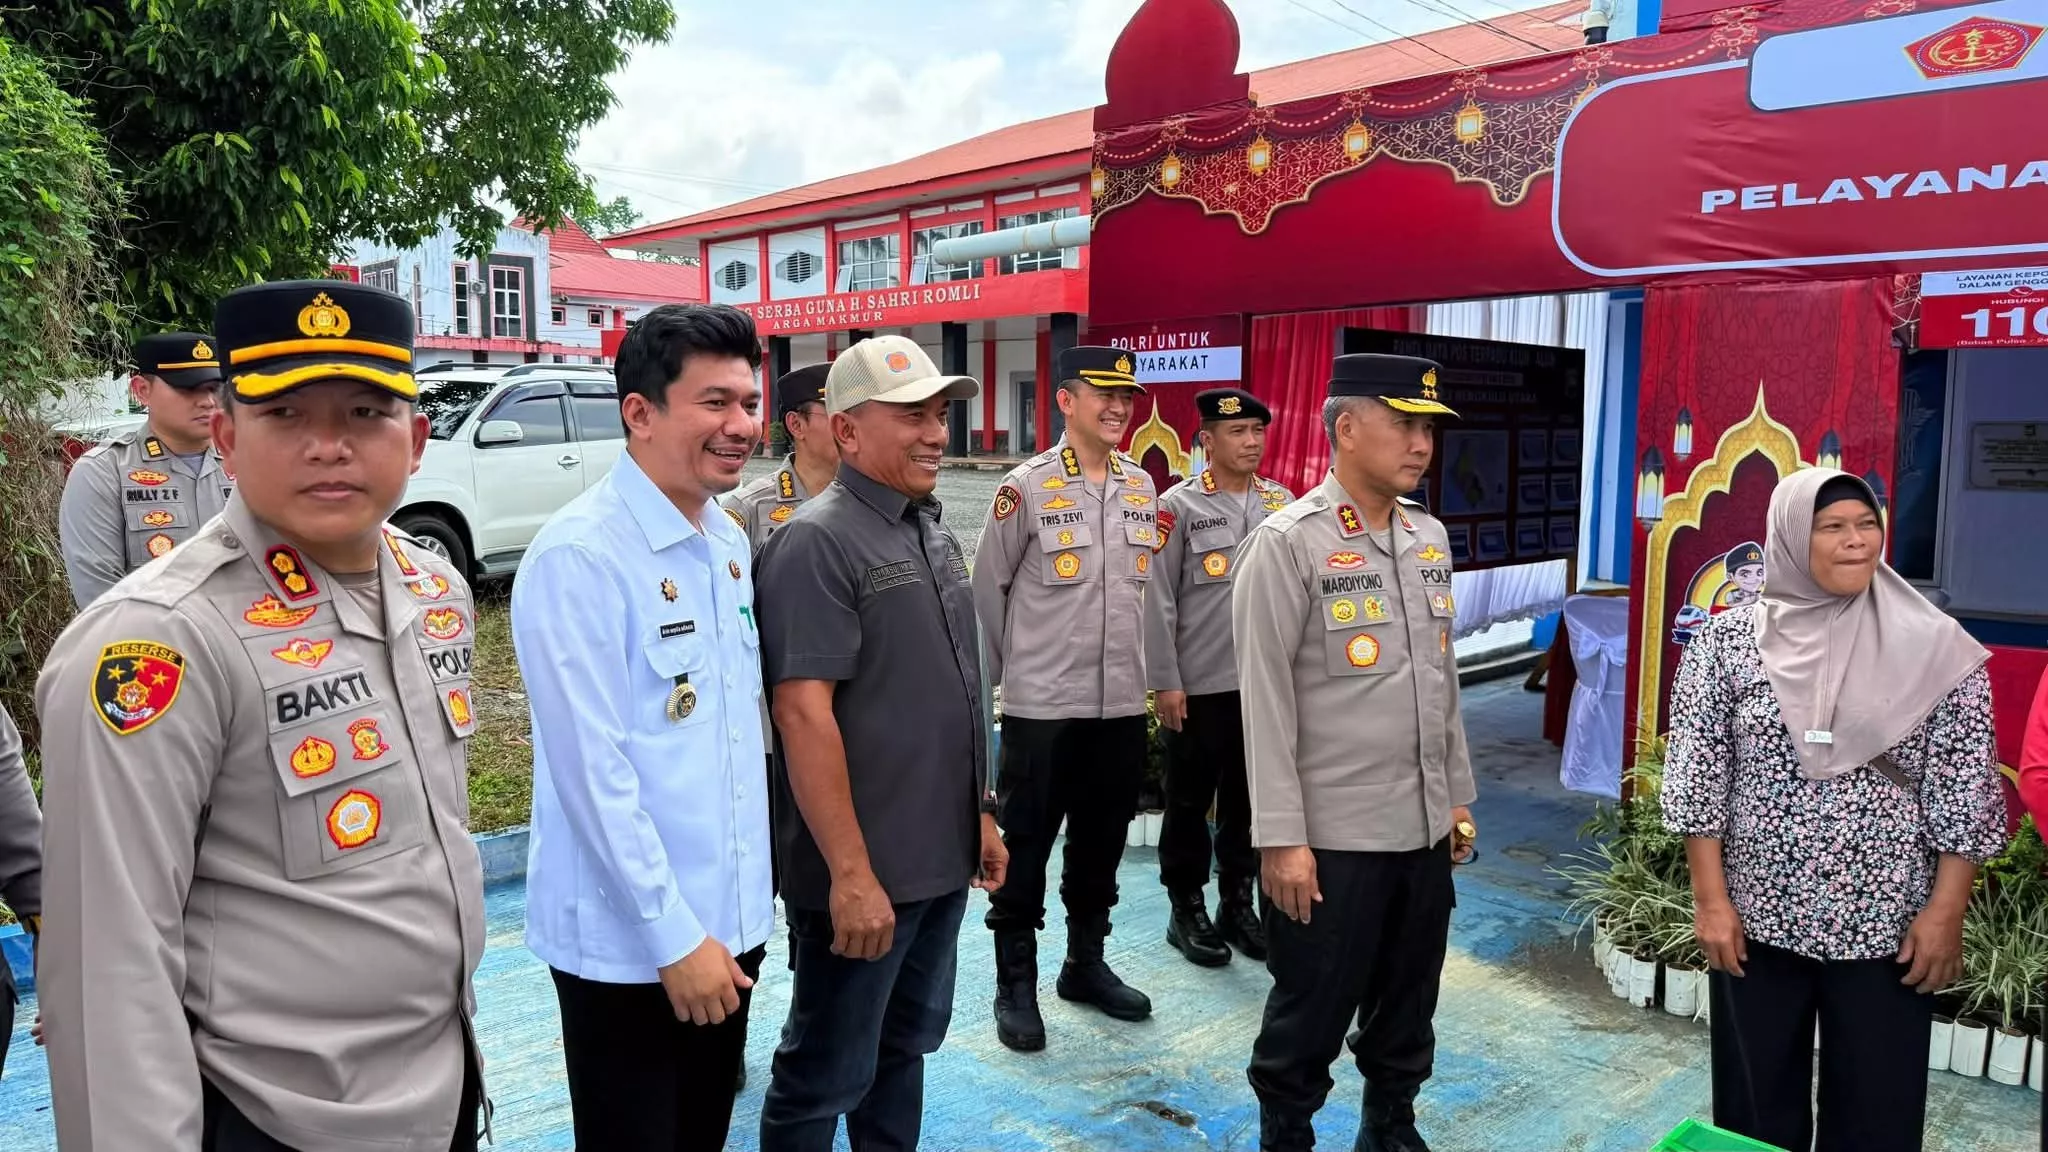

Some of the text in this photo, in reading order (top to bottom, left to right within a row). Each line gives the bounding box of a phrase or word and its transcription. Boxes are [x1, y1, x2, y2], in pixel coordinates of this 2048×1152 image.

[1701, 160, 2048, 214] PELAYANA
[1956, 273, 2012, 282] LAYANAN
[1958, 281, 2001, 289] DALAM
[757, 303, 801, 319] SERBA
[806, 299, 845, 315] GUNA
[851, 298, 864, 312] H.
[867, 290, 918, 309] SAHRI
[923, 283, 980, 304] ROMLI
[1991, 297, 2045, 305] HUBUNGI
[773, 311, 883, 330] ARGA MAKMUR
[1961, 306, 2048, 338] 110
[1111, 331, 1210, 351] POLRI UNTUK
[1137, 355, 1209, 372] YARAKAT
[1040, 511, 1084, 527] TRIS ZEVI
[1123, 510, 1155, 524] POLRI
[1190, 517, 1228, 532] AGUNG
[1321, 573, 1383, 595] MARDIYONO
[112, 643, 178, 662] RESERSE
[276, 671, 373, 724] BAKTI
